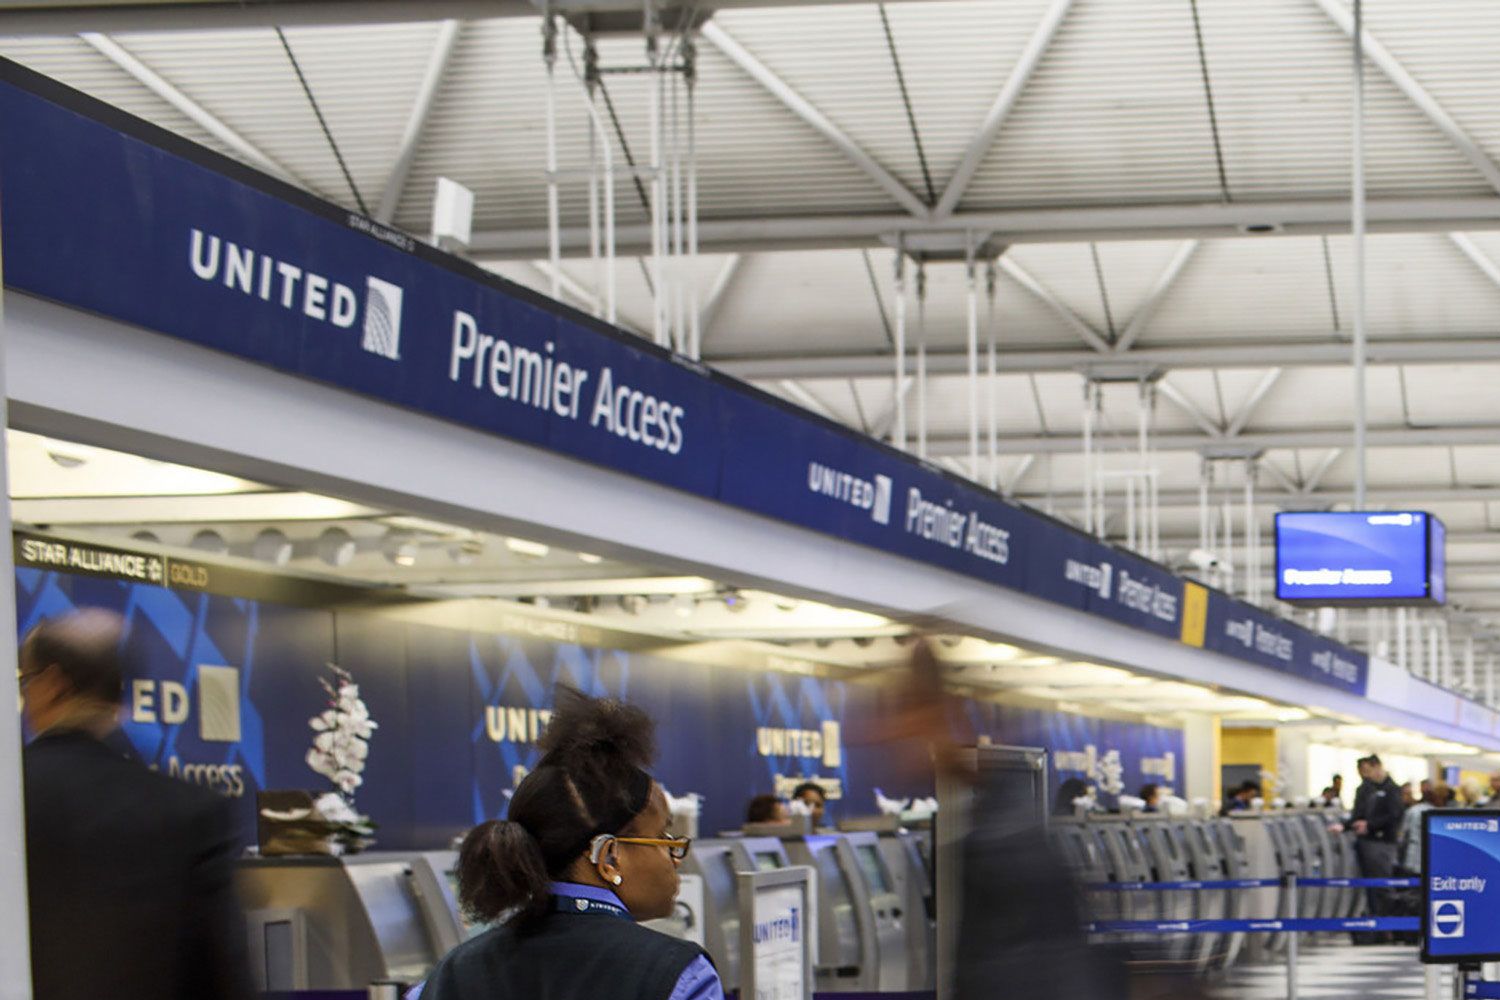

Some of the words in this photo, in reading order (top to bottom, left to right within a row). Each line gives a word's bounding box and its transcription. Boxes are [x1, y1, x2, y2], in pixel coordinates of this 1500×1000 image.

[190, 227, 357, 329] UNITED
[449, 309, 588, 421] Premier
[590, 366, 685, 455] Access
[808, 461, 875, 511] UNITED
[905, 486, 967, 550] Premier
[964, 510, 1010, 566] Access
[22, 538, 68, 566] STAR
[69, 546, 147, 579] ALLIANCE
[170, 562, 209, 589] GOLD
[756, 726, 823, 760] UNITED
[1431, 876, 1458, 891] Exit
[1458, 877, 1487, 893] only
